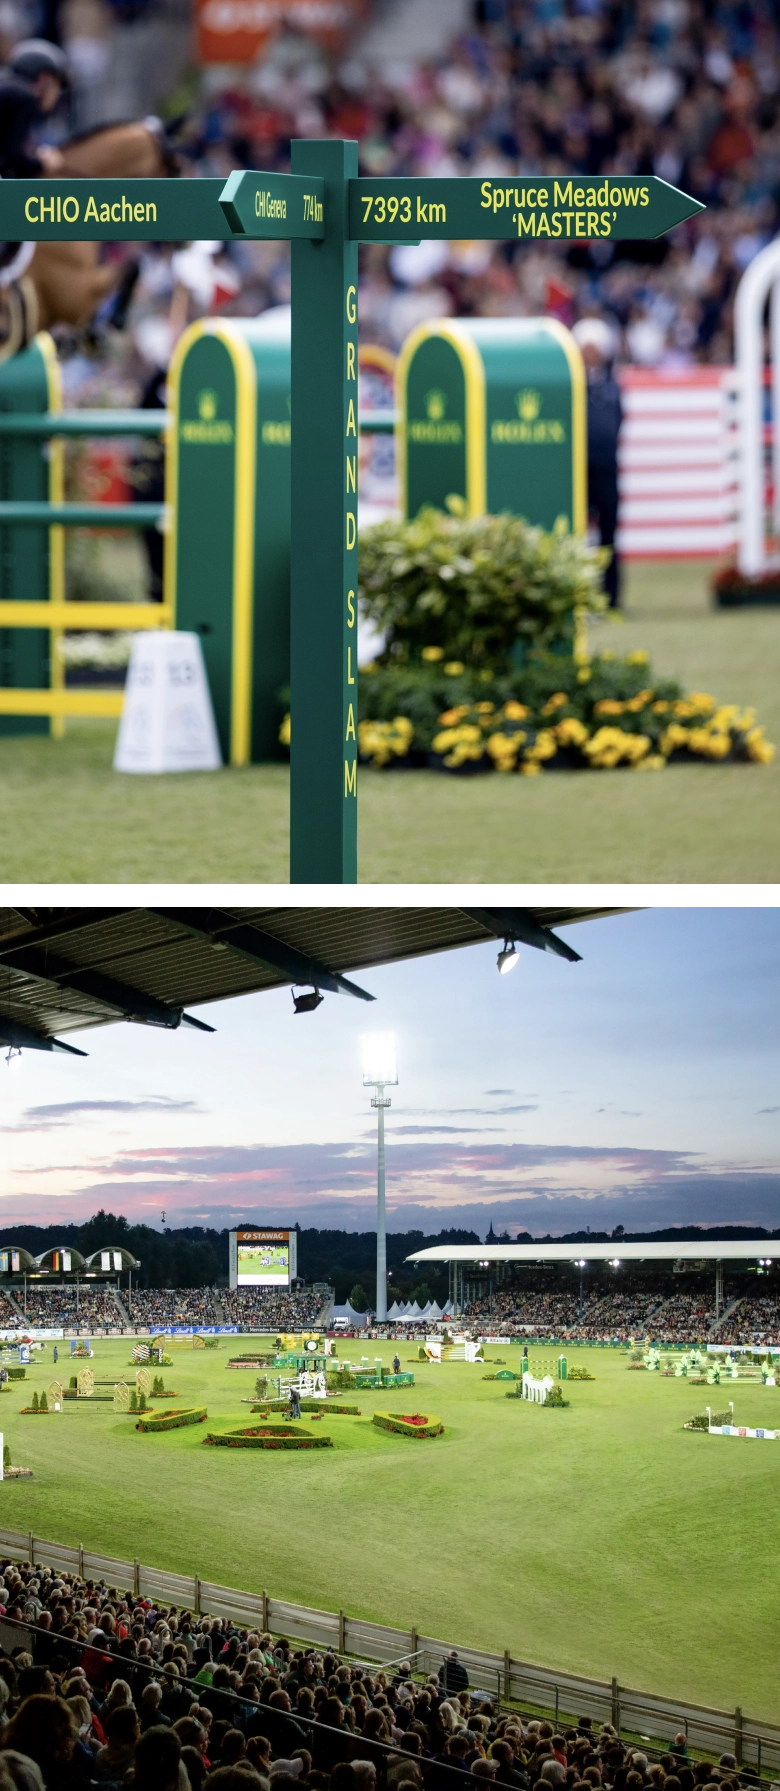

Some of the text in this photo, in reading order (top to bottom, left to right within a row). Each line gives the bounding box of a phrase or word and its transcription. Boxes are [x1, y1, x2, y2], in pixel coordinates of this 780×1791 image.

[24, 195, 157, 223] CHIO Aachen
[255, 191, 287, 219] CHI Geneva
[303, 194, 324, 222] 774 km
[361, 196, 447, 223] 7393 km
[480, 180, 650, 213] Spruce Meadows
[344, 285, 357, 798] GRAND SLAM
[252, 1232, 284, 1240] STAWAG
